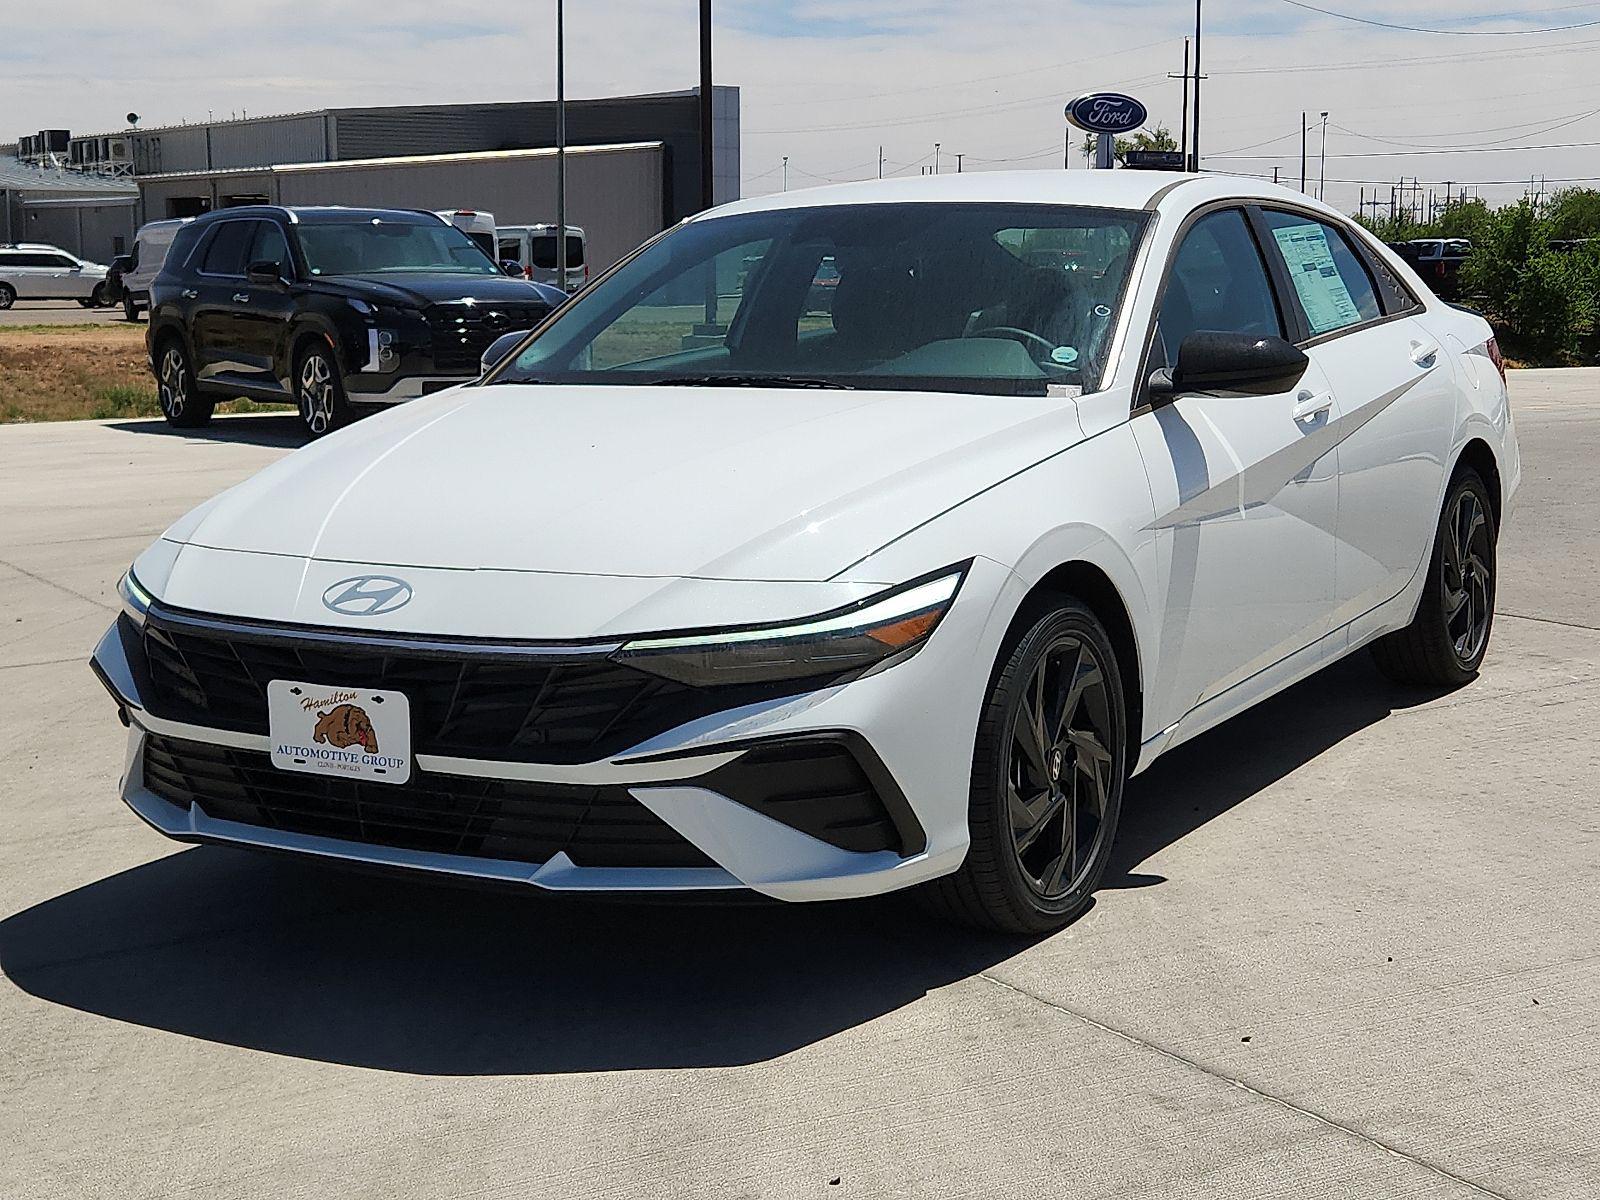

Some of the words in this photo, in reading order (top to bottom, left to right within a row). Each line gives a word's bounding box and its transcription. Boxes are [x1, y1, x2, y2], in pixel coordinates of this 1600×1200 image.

[1088, 99, 1132, 125] Ford
[300, 691, 358, 712] Hamilton
[276, 745, 359, 763] AUTOMOTIVE
[361, 755, 404, 768] GROUP
